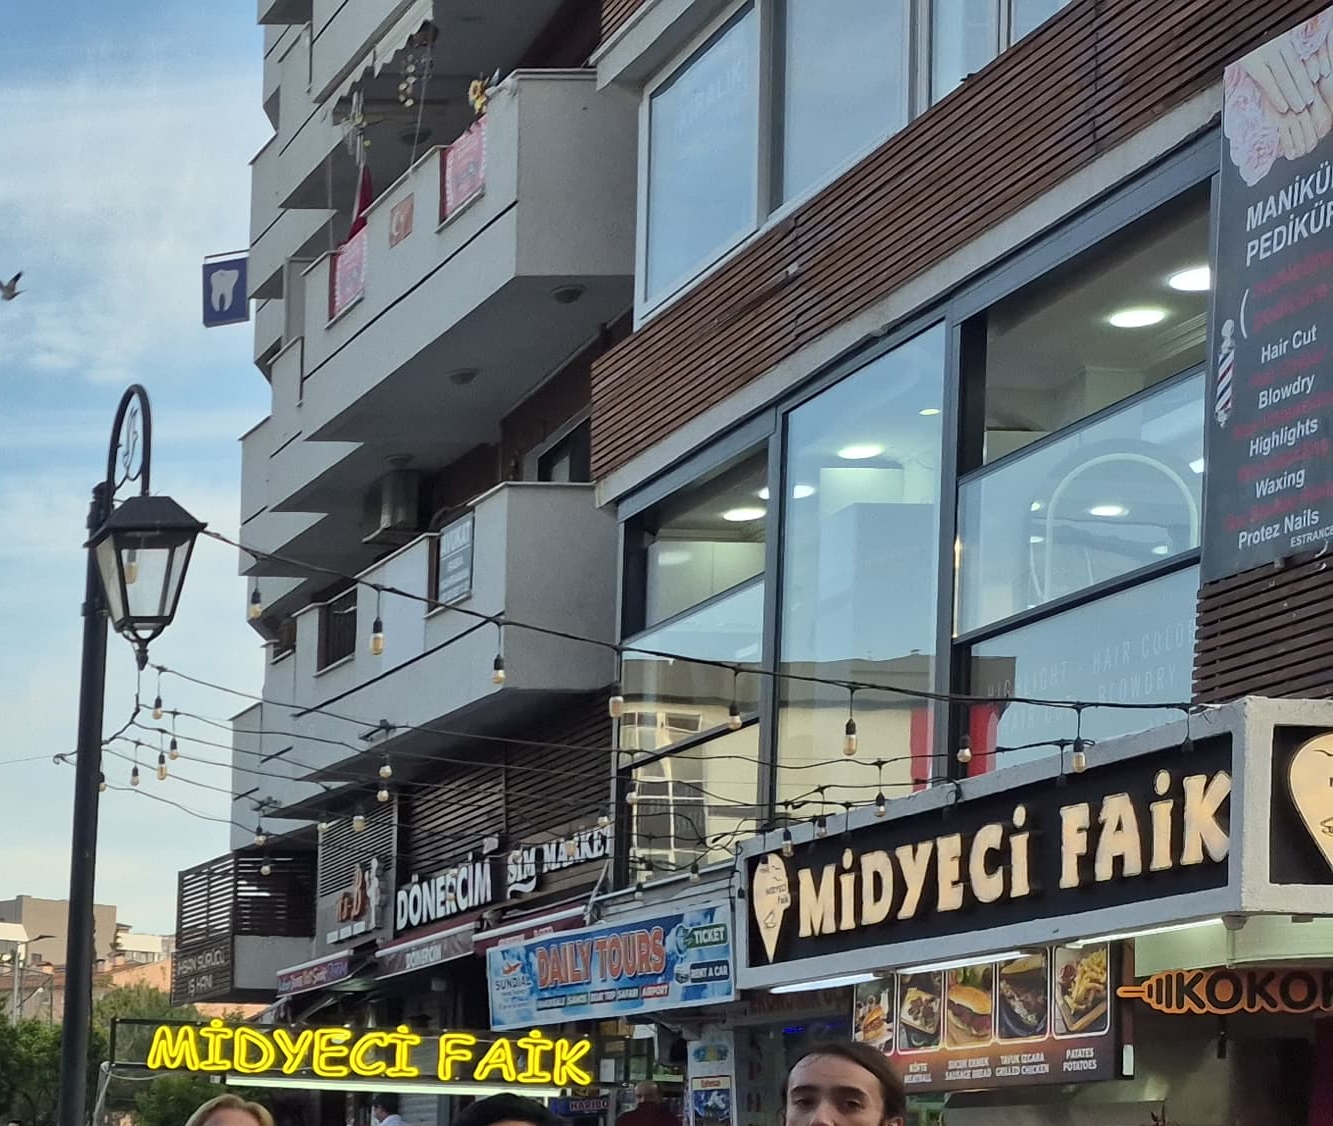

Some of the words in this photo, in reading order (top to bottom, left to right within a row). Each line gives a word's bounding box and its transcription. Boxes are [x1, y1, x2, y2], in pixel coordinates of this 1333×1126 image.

[1246, 160, 1333, 232] MANİKÜ
[1261, 338, 1289, 363] Hair
[1292, 324, 1317, 349] Cut
[1258, 374, 1315, 409] Blowdry
[1249, 418, 1318, 457] Highlights
[1255, 468, 1305, 499] Waxing
[1238, 523, 1280, 549] Protez
[1284, 509, 1319, 532] Nails
[396, 854, 492, 931] DÖNERCİM
[693, 926, 726, 945] TICKET
[536, 938, 594, 990] DAILY
[595, 925, 668, 981] TOURS
[714, 964, 729, 977] CAR
[146, 1019, 421, 1078] MİDYECİ
[437, 1029, 594, 1087] FAİK
[1063, 1060, 1097, 1072] POTATOES
[1065, 1048, 1094, 1060] PATATES
